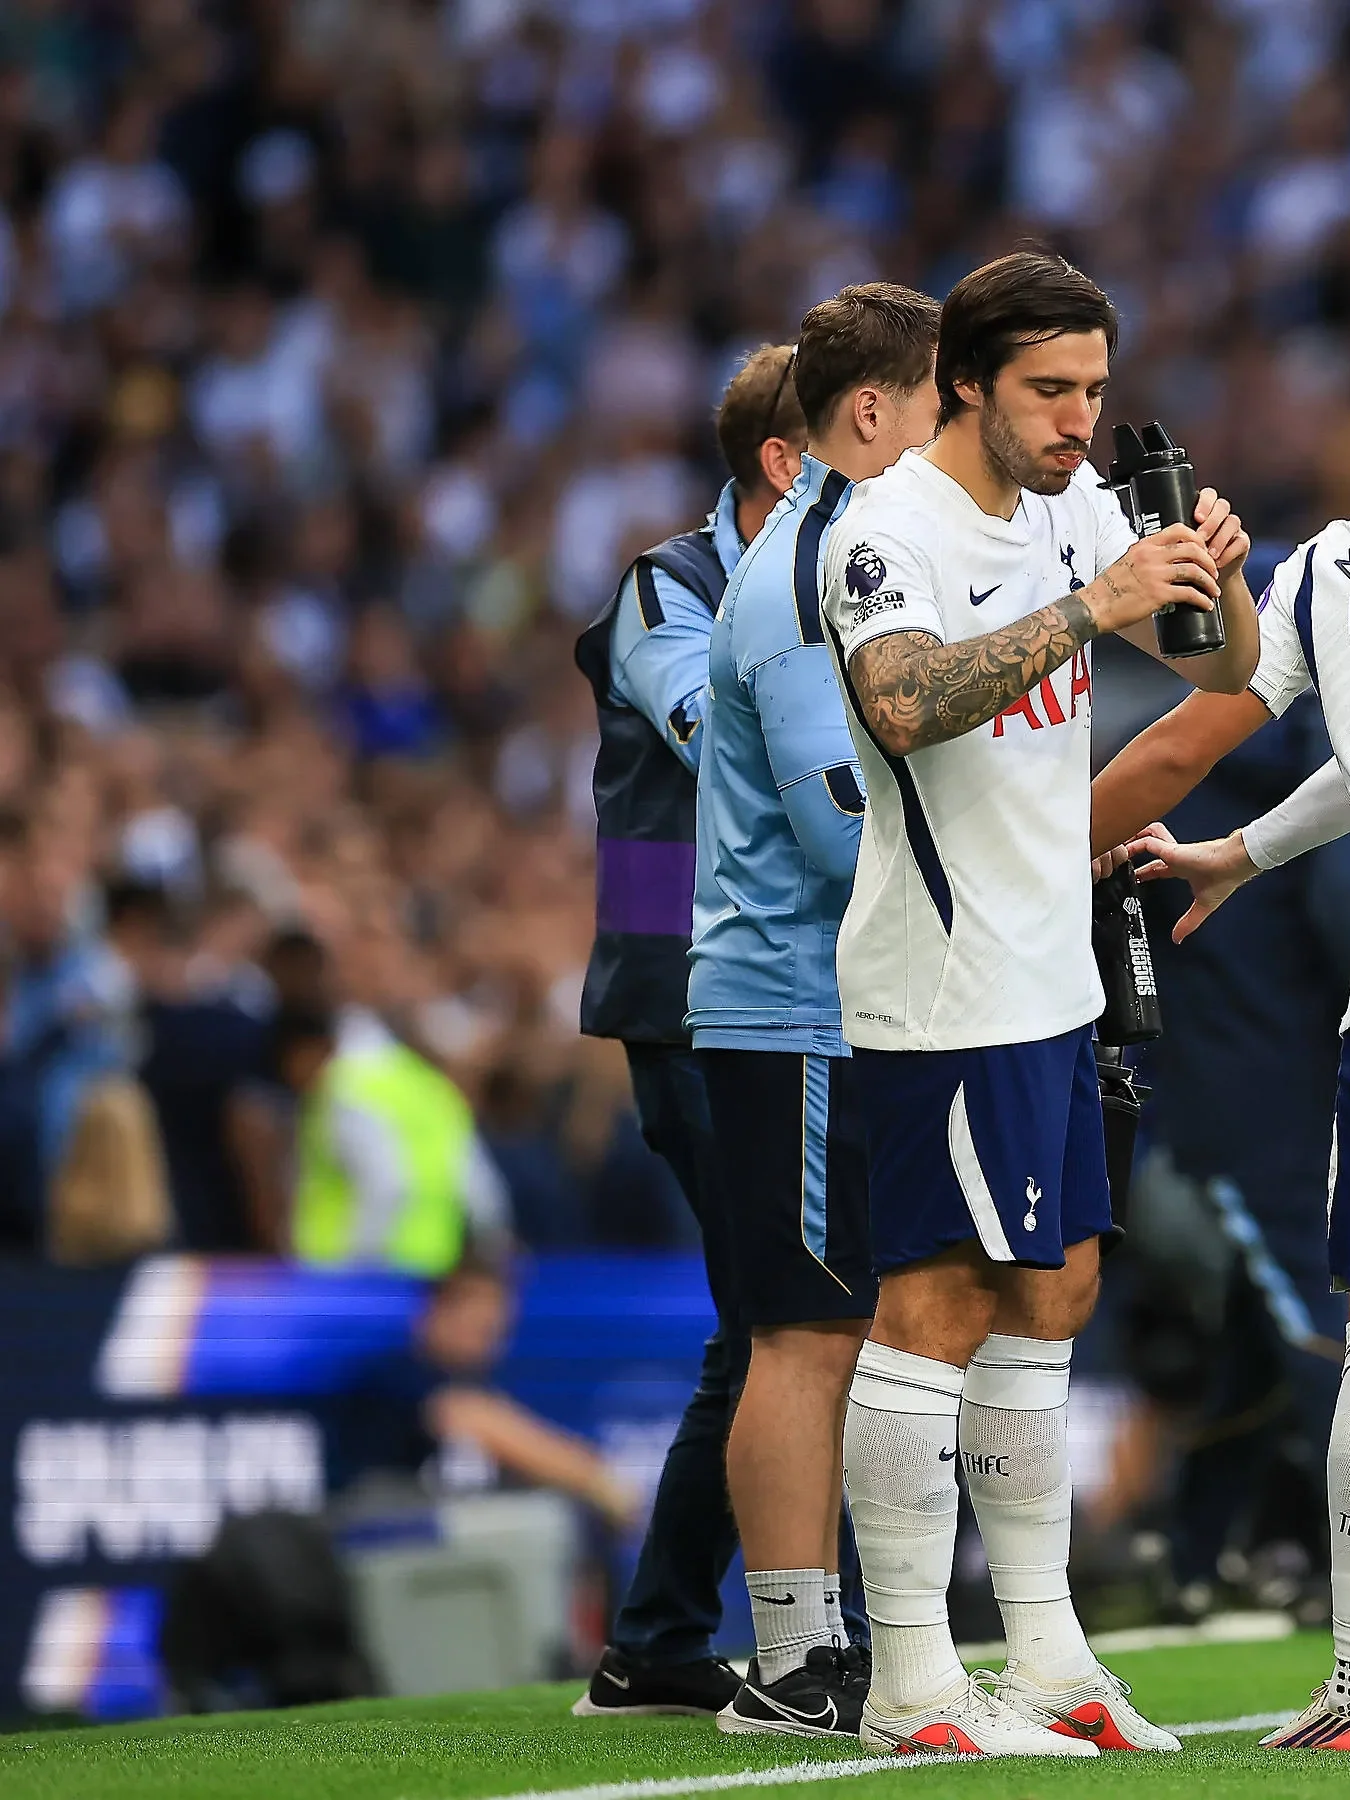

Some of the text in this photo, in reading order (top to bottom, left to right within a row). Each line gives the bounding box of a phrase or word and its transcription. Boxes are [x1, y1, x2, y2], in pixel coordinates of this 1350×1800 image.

[1128, 937, 1153, 996] SOCCER
[855, 1011, 892, 1024] AERO-FIT
[962, 1451, 1010, 1477] THFC
